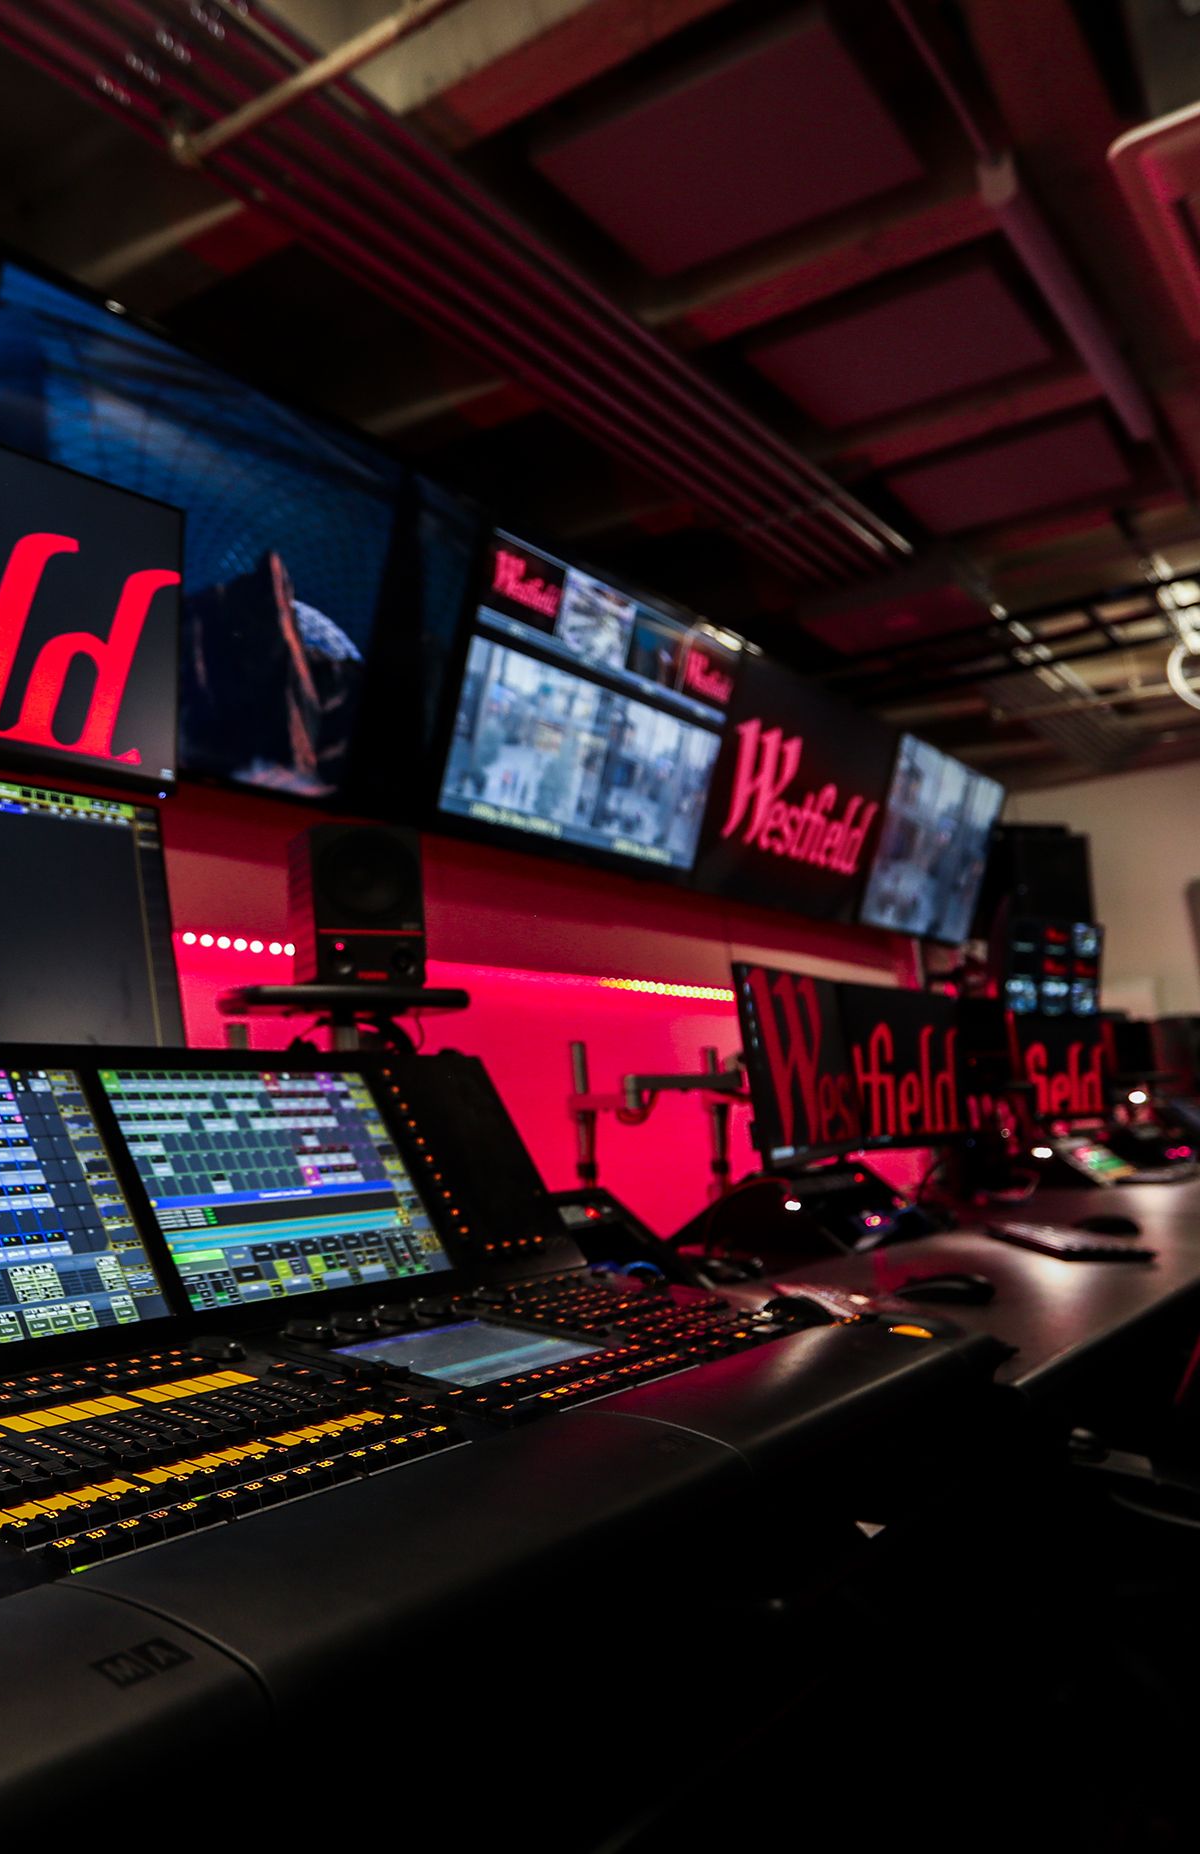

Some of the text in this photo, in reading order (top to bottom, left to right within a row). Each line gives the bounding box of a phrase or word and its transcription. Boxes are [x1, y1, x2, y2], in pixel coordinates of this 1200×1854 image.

[720, 718, 878, 876] Westfield
[292, 1466, 311, 1475] 124
[268, 1473, 288, 1483] 123
[243, 1481, 264, 1491] 122
[217, 1490, 238, 1500] 121
[176, 1500, 198, 1512] 120
[43, 1510, 59, 1520] 17
[11, 1519, 28, 1530] 16
[117, 1518, 140, 1530] 118
[85, 1529, 108, 1540] 117
[52, 1537, 76, 1549] 116
